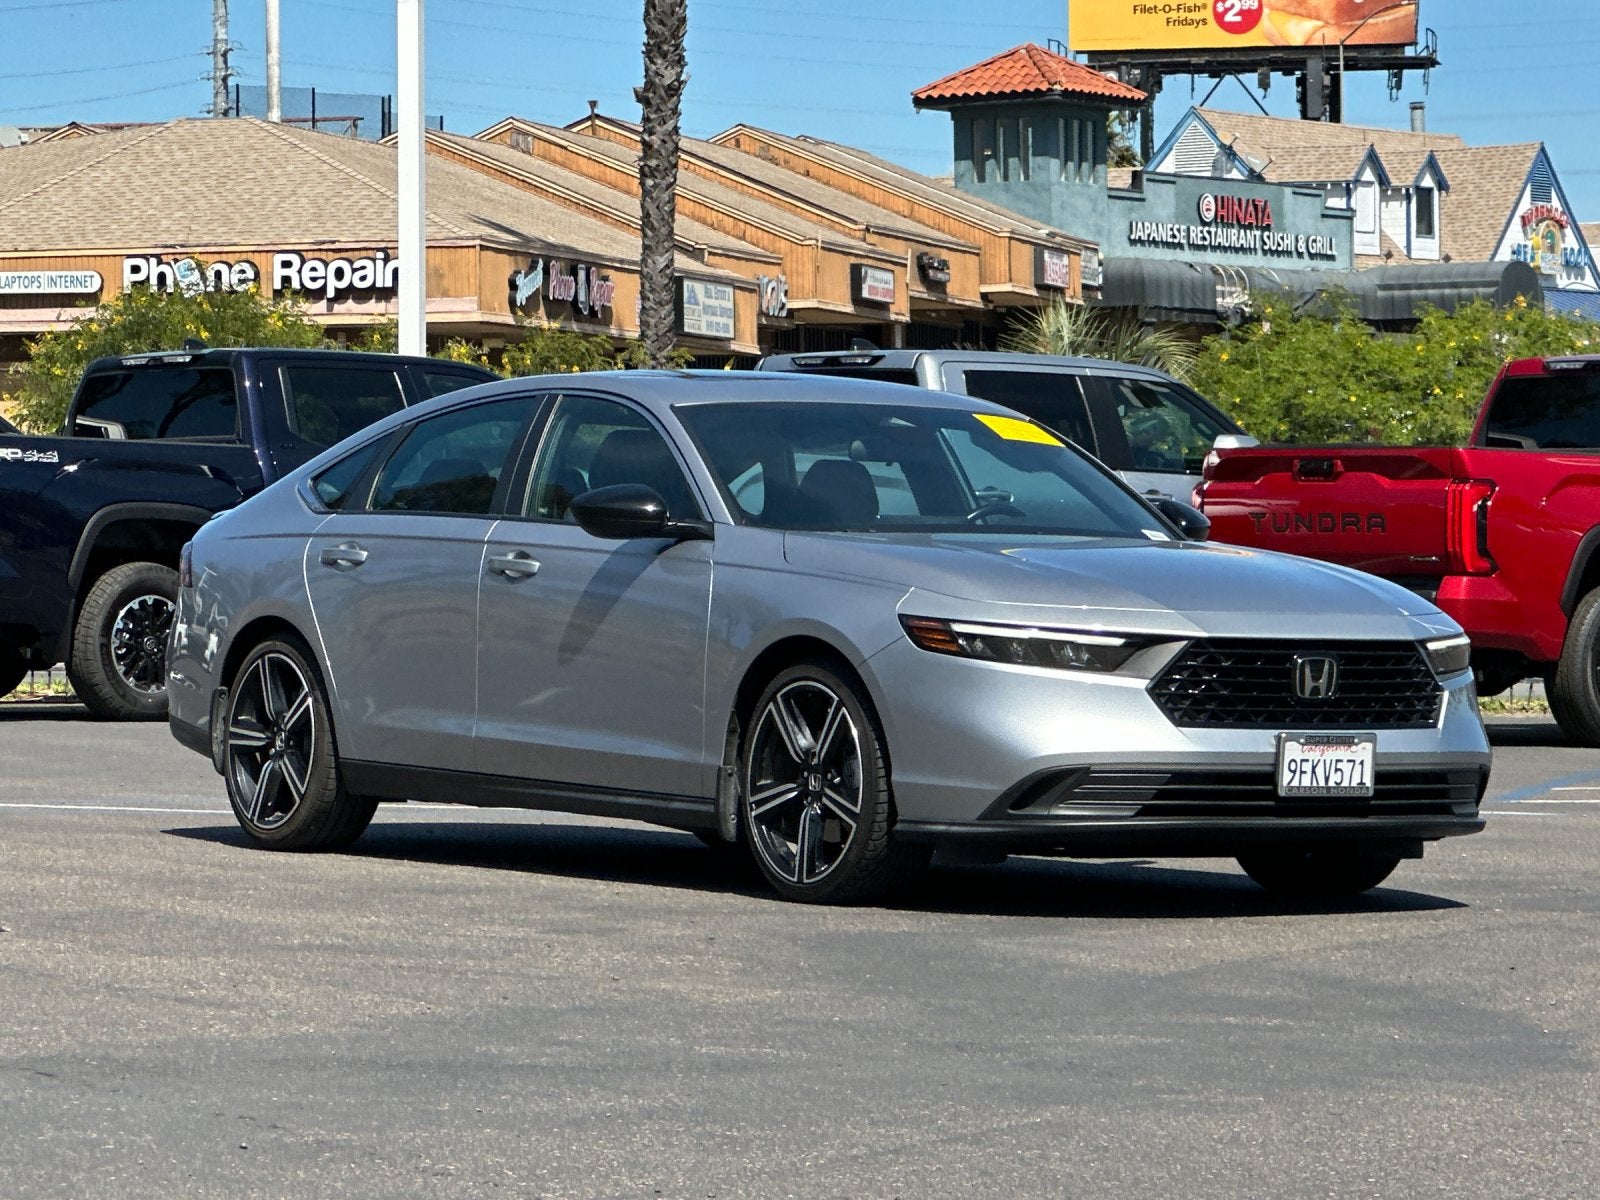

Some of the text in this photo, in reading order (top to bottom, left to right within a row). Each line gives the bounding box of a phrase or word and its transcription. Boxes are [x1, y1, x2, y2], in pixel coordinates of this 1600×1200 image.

[1166, 16, 1207, 28] Fridays
[1216, 195, 1273, 227] HINATA
[1130, 221, 1337, 256] JAPANESE RESTAURANT SUSHI & GRILL
[0, 275, 42, 289] LAPTOPS
[47, 274, 94, 289] INTERNET
[549, 260, 576, 301] Phone
[590, 266, 615, 319] Repair
[1249, 512, 1387, 534] TUNDRA
[1301, 744, 1357, 757] California
[1287, 758, 1367, 786] 9FKV571
[1286, 787, 1369, 795] CARSON HONDA
